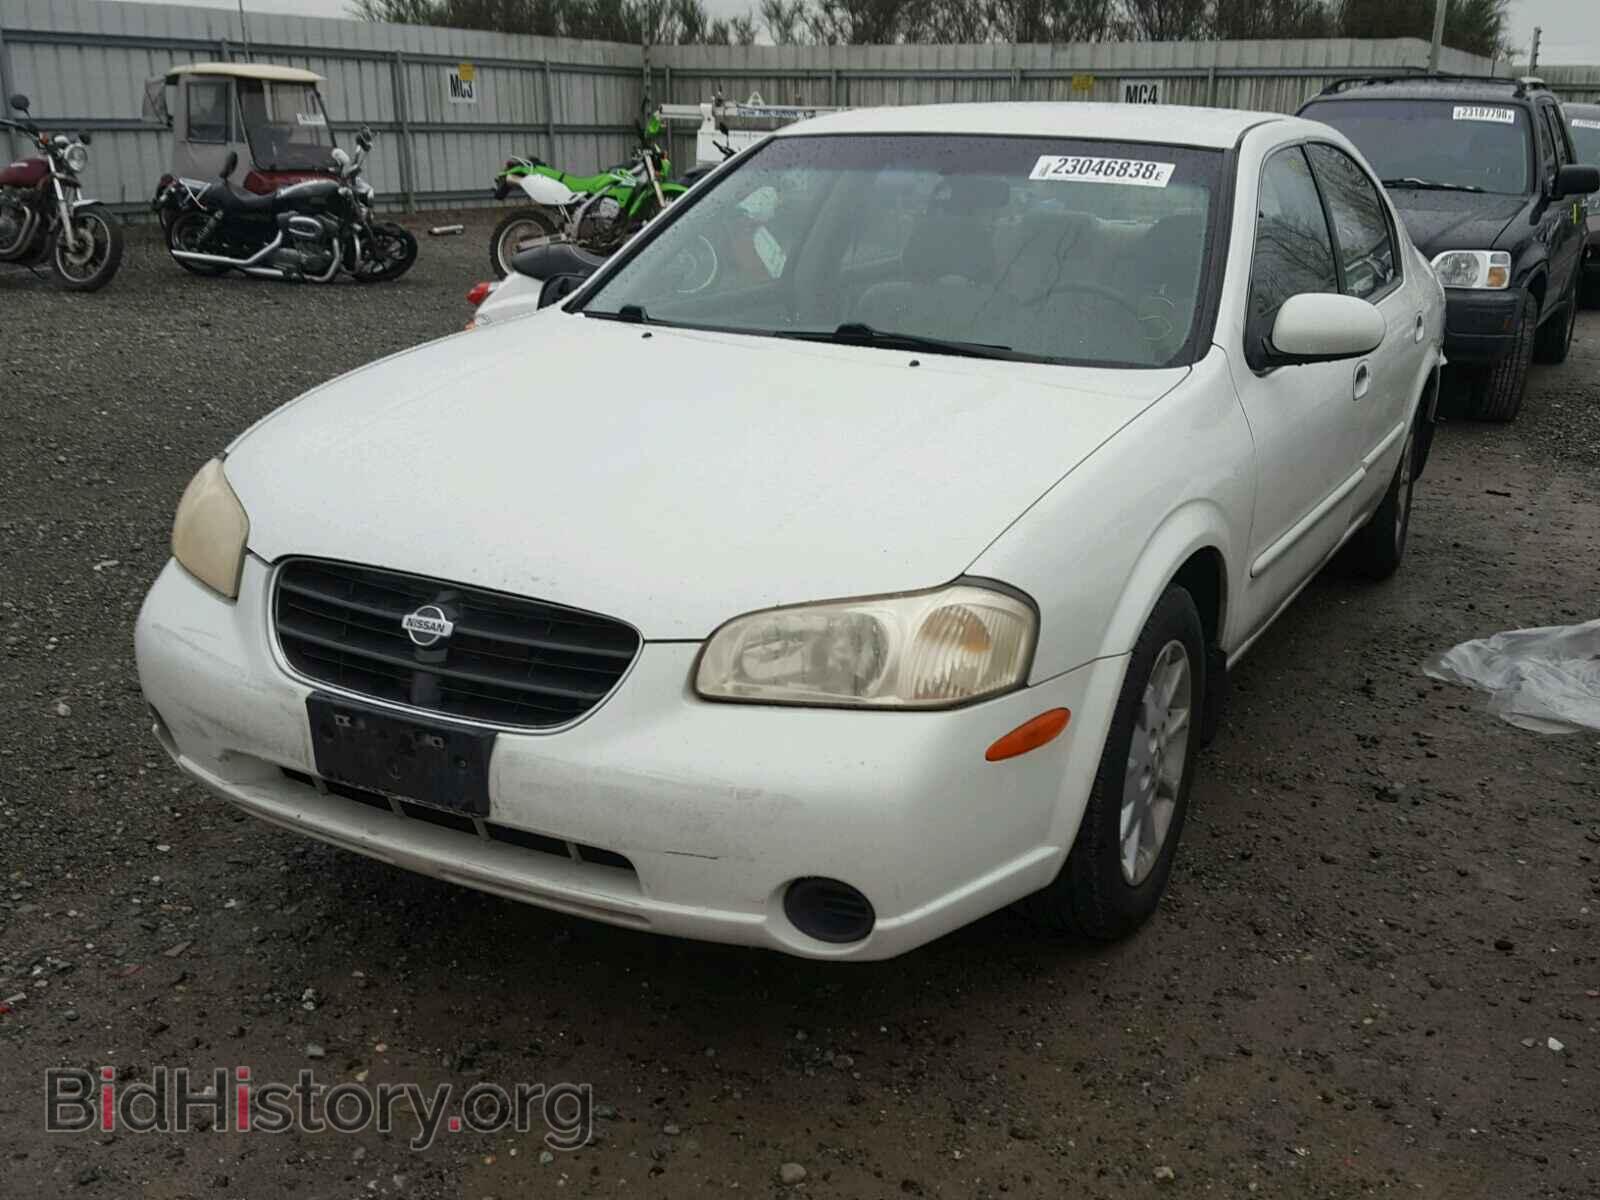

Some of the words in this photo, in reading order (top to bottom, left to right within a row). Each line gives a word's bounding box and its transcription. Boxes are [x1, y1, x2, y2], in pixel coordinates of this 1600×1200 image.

[1125, 84, 1158, 104] MC4
[1052, 157, 1157, 180] 23046838
[406, 616, 446, 633] NISSAN
